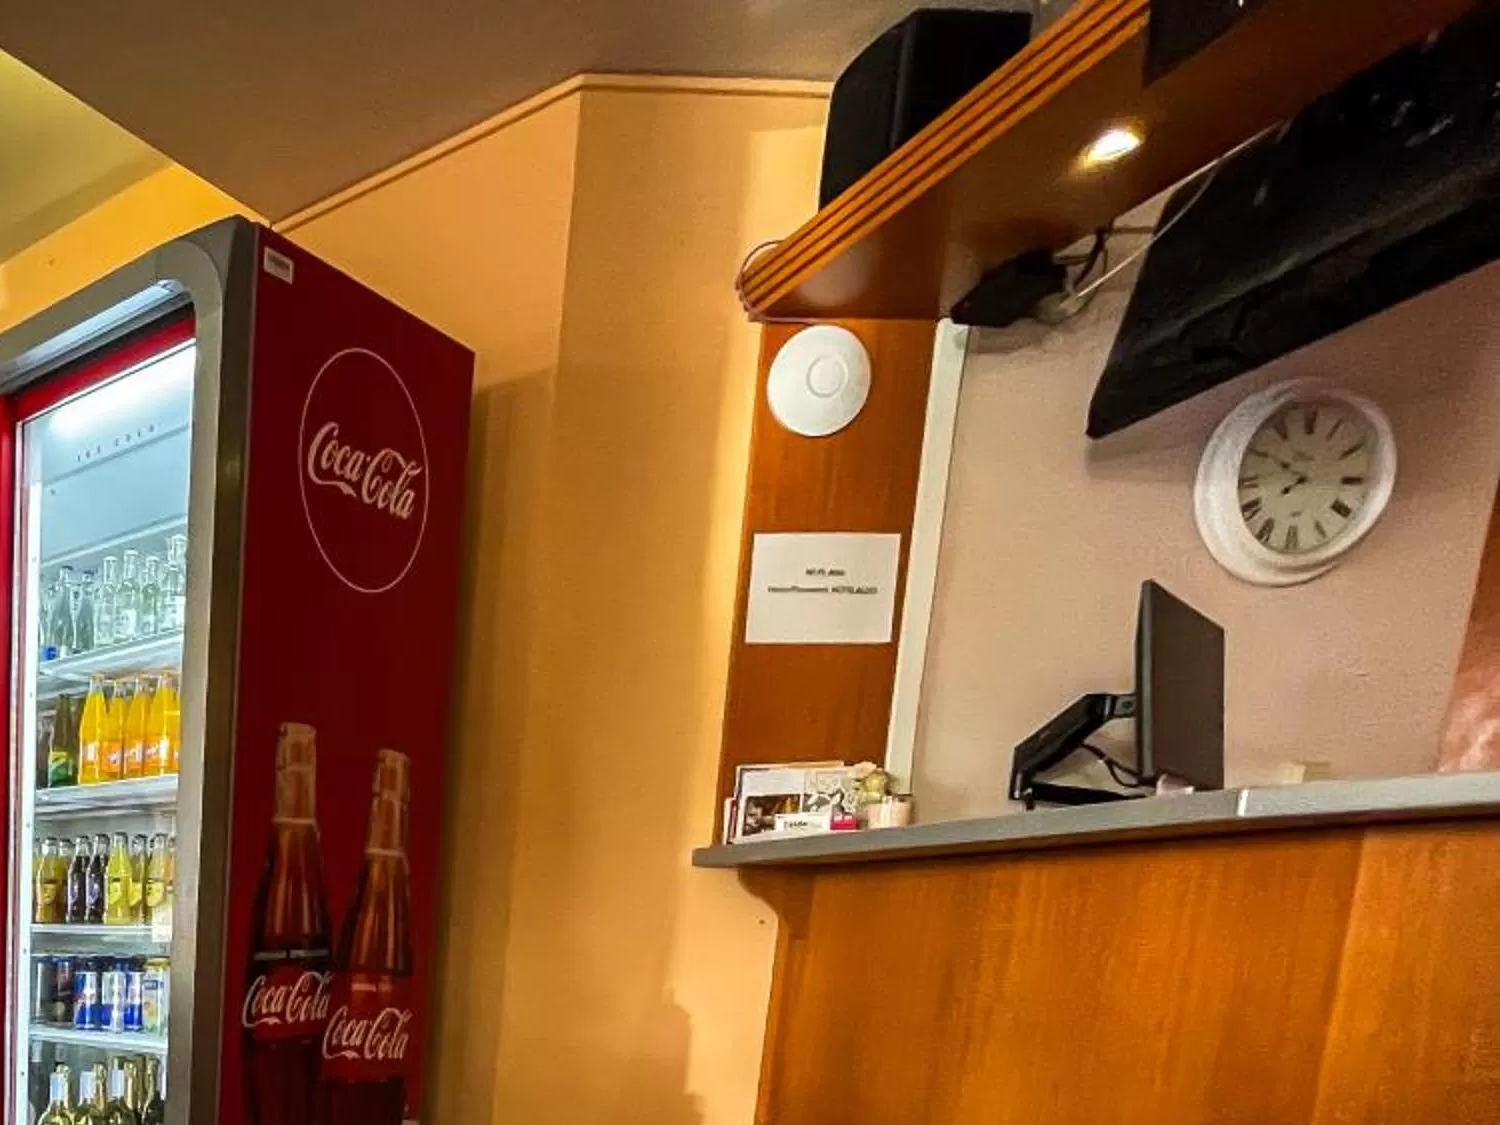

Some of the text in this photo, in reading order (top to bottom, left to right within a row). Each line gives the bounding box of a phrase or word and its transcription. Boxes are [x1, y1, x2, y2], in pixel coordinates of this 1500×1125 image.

[307, 422, 422, 520] Coca-Cola
[242, 971, 333, 1028] Coca-Cola
[322, 1007, 413, 1060] Coca-Cola
